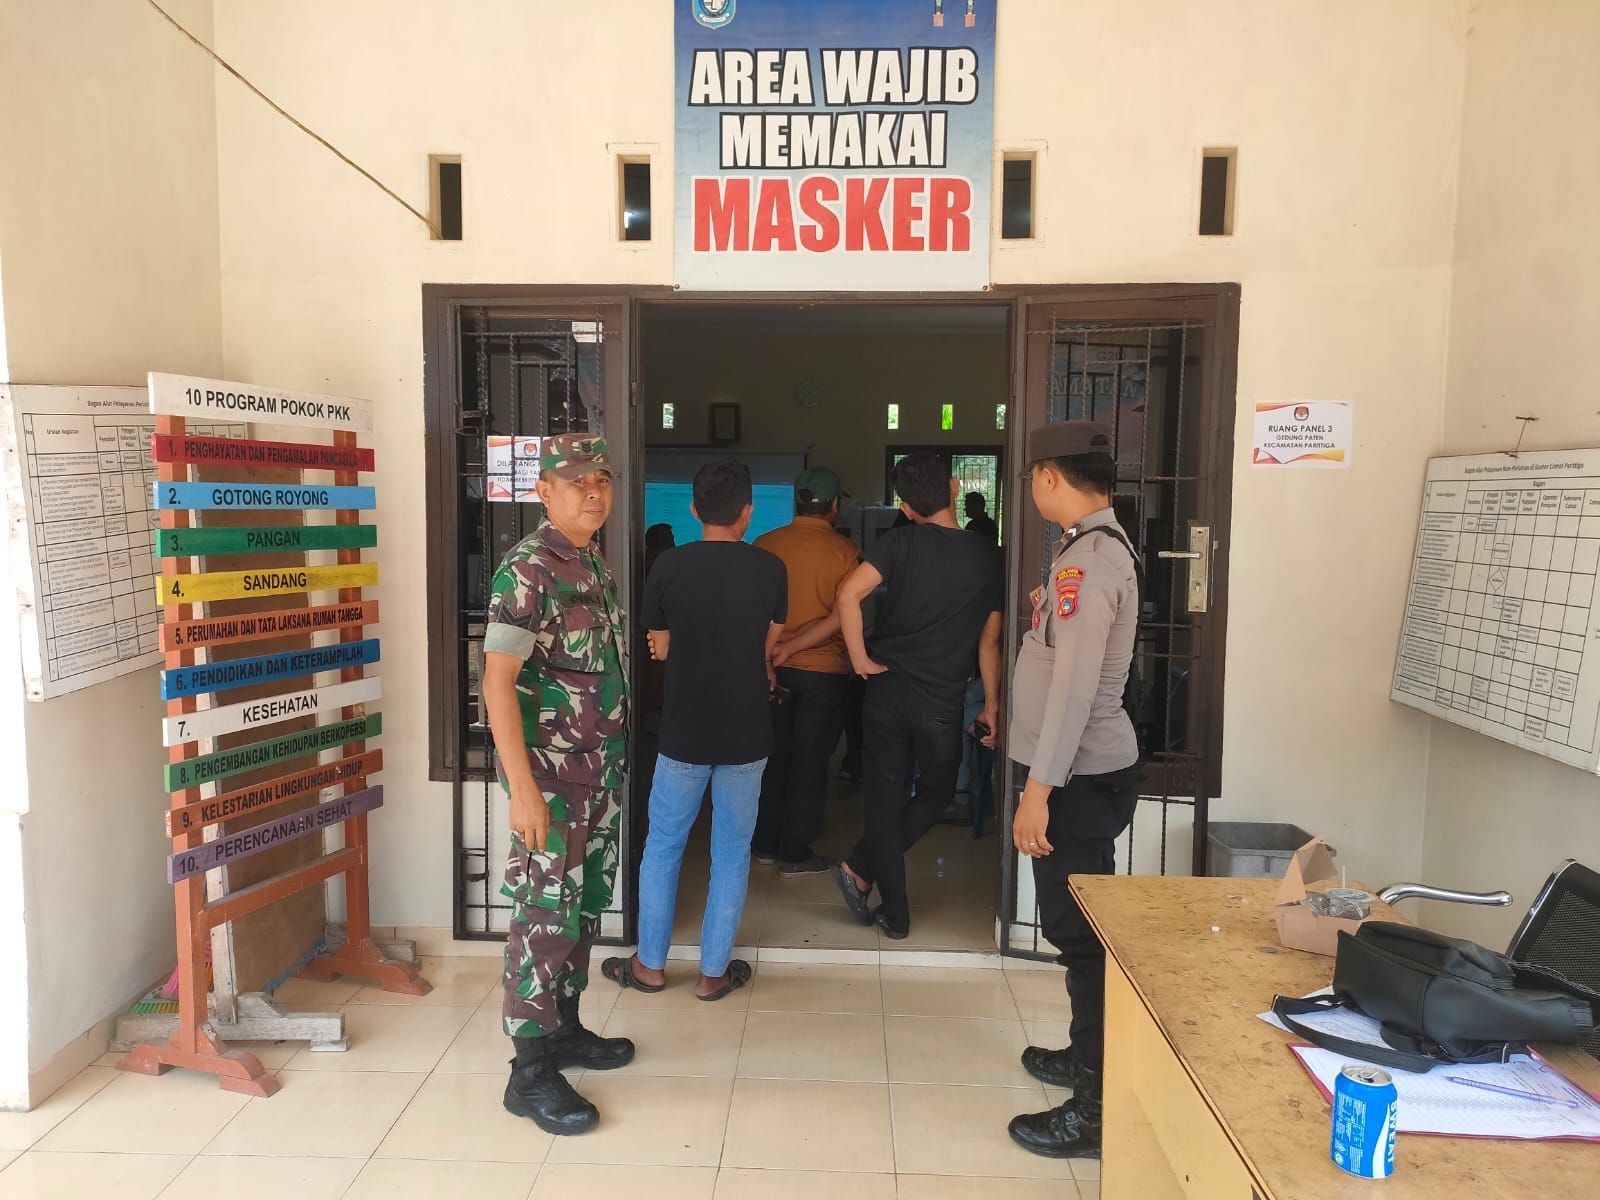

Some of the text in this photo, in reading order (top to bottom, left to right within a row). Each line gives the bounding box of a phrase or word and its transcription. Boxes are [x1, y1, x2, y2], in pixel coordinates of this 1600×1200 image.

[688, 46, 978, 106] AREA WAJIB
[719, 110, 948, 169] MEMAKAI
[693, 176, 972, 252] MASKER
[186, 388, 351, 421] 10 PROGRAM POKOK PKK
[1268, 425, 1333, 433] RUANG PANEL 3
[168, 440, 177, 457] 1.
[184, 441, 246, 461] PENGHAYATAN
[248, 446, 265, 462] DAN
[267, 447, 319, 464] PENGAMALAN
[168, 487, 329, 506] 2. GOTONG ROYONG
[171, 531, 300, 551] 3. PANGAN
[171, 572, 307, 597] 4. SANDANG
[175, 606, 363, 645] 5. PERUMAHAN DAN TATA LAKSANA RUMAH TANGGA
[176, 645, 363, 691] 6. PENDIDIKAN DAN KETERAMPILAN
[178, 693, 318, 737] 7. KESEHATAN
[180, 720, 366, 784] 8. PENGEMBANGAN KEHIDUPAN BERKOPERSI
[182, 760, 363, 828] 9. KELESTARIAN LINGKUNGAN HIDUP
[179, 800, 353, 874] 10. PERENCANAAN SEHAT
